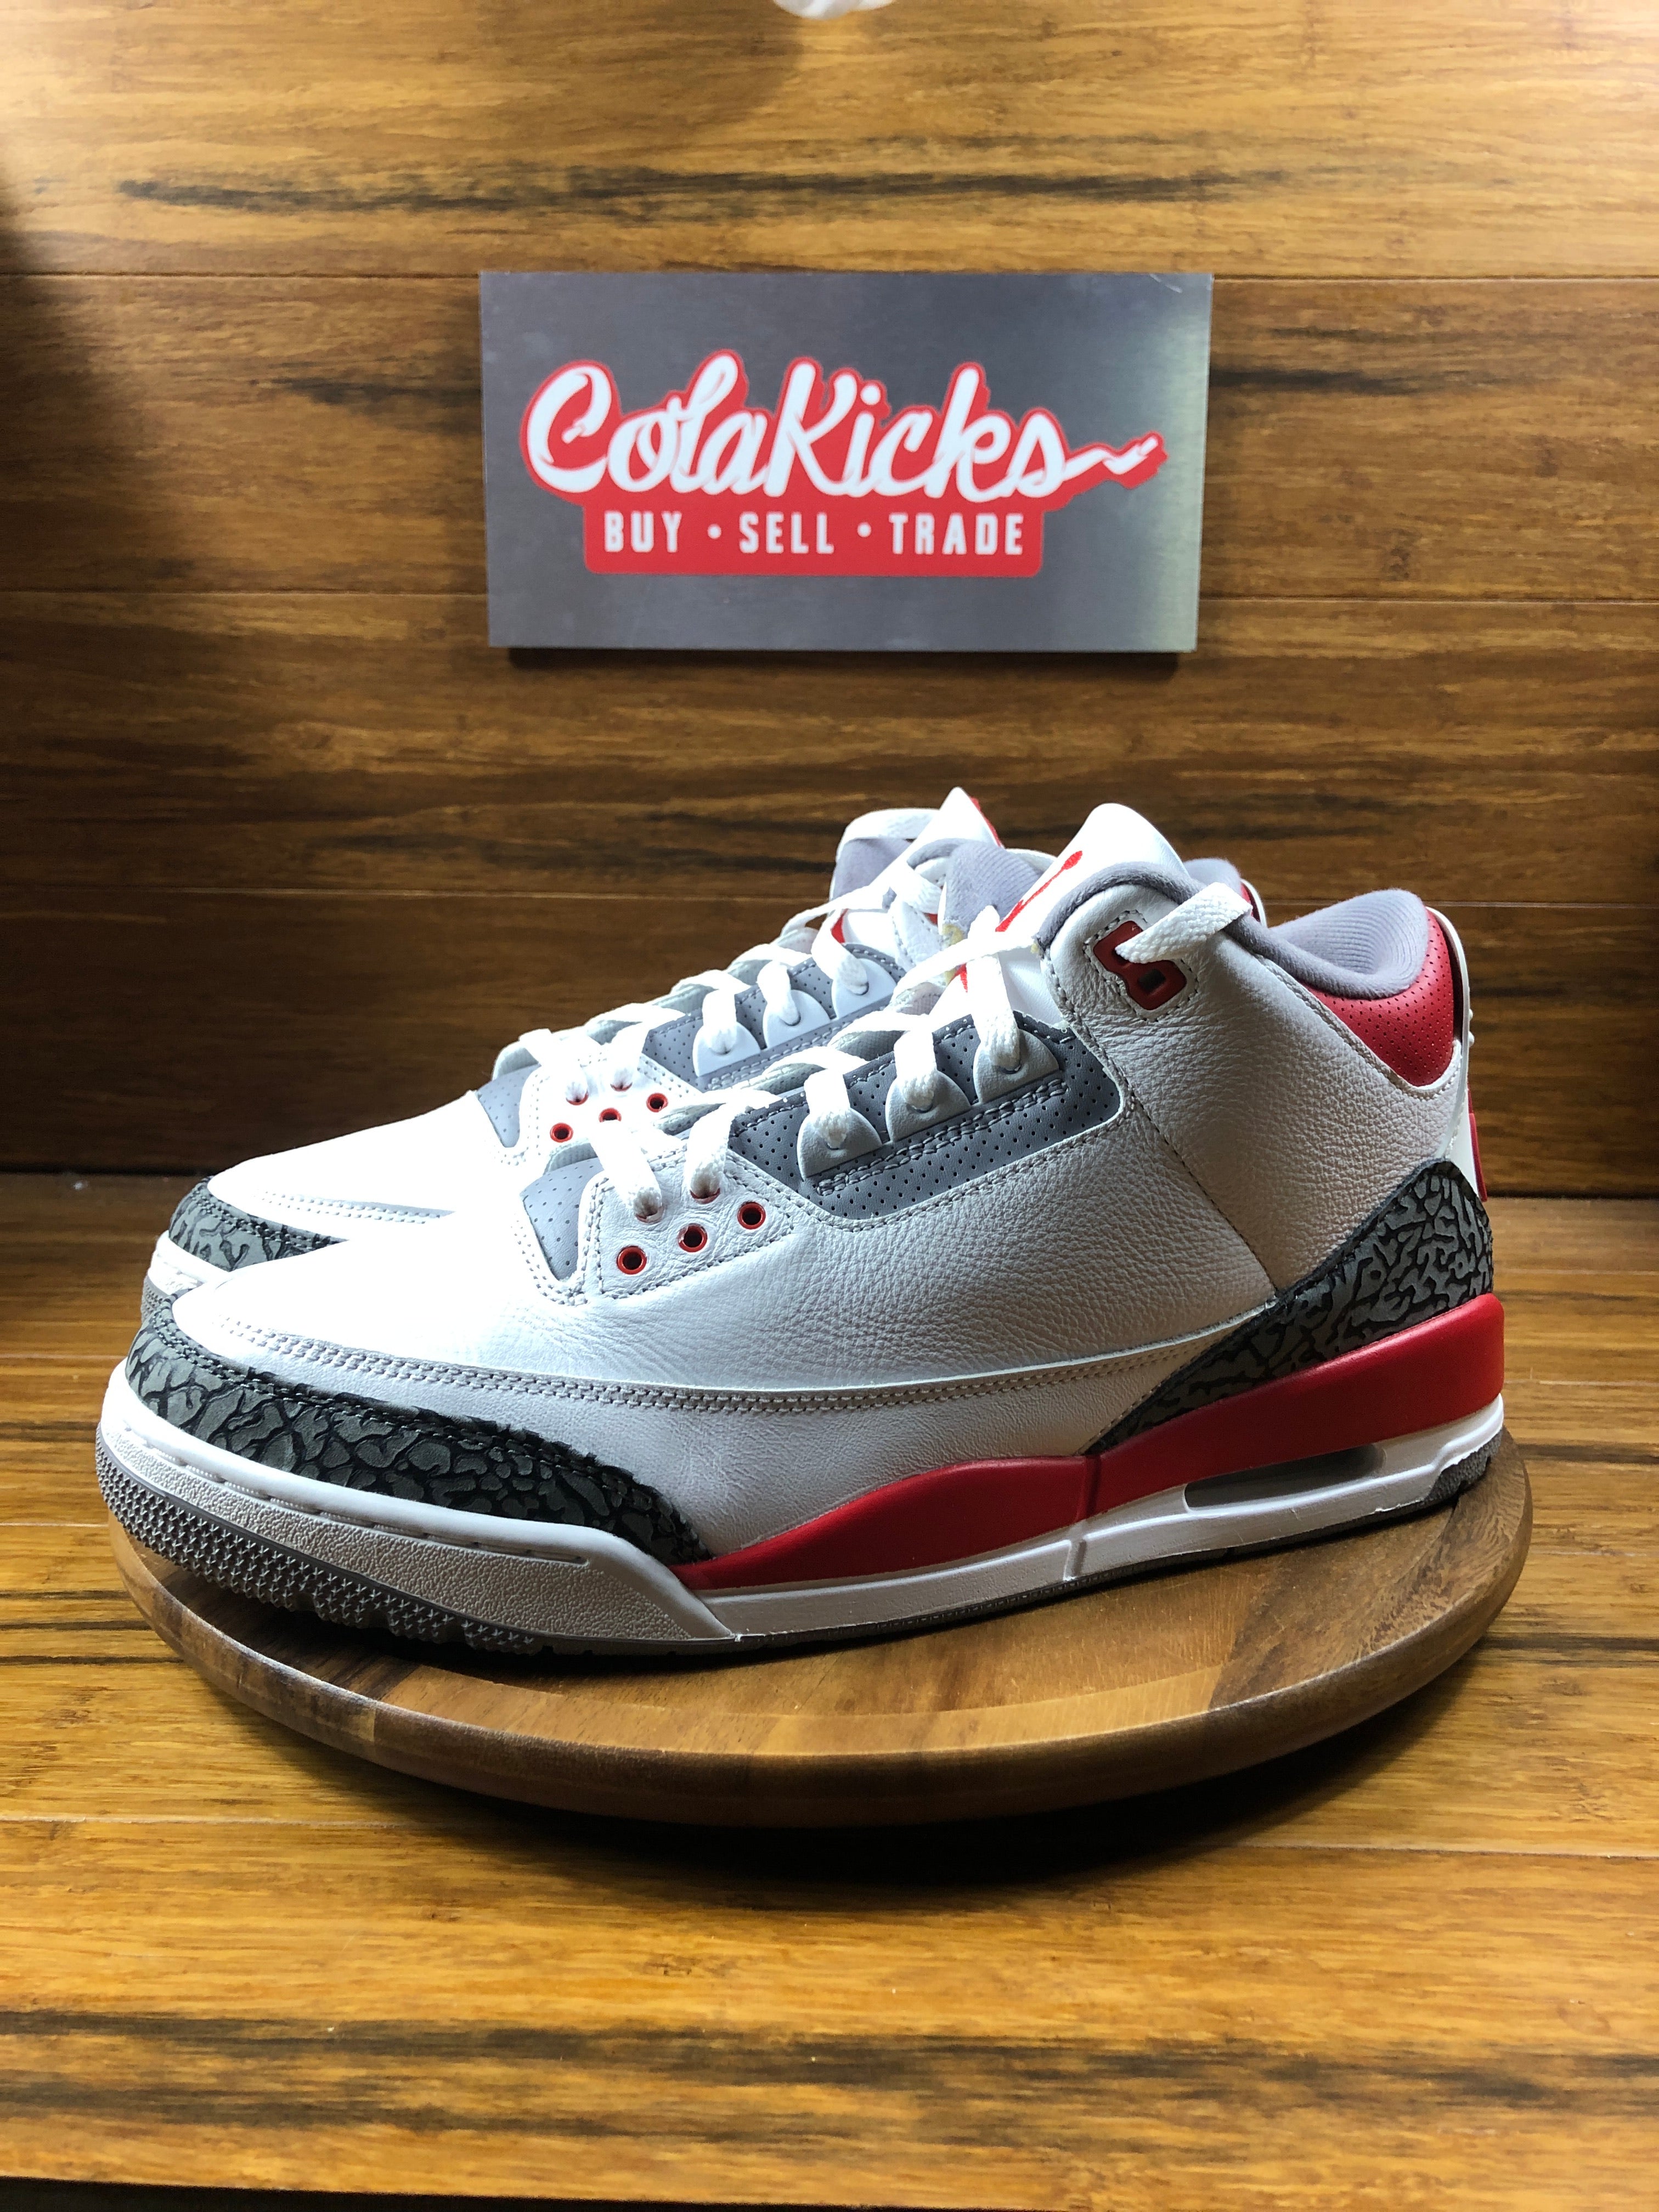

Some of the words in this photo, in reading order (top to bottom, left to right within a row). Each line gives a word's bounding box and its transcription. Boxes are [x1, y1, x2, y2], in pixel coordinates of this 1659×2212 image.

[527, 354, 1159, 503] ColaKicks
[603, 511, 682, 553] BUY
[739, 512, 834, 554] SELL
[888, 513, 1024, 555] TRADE
